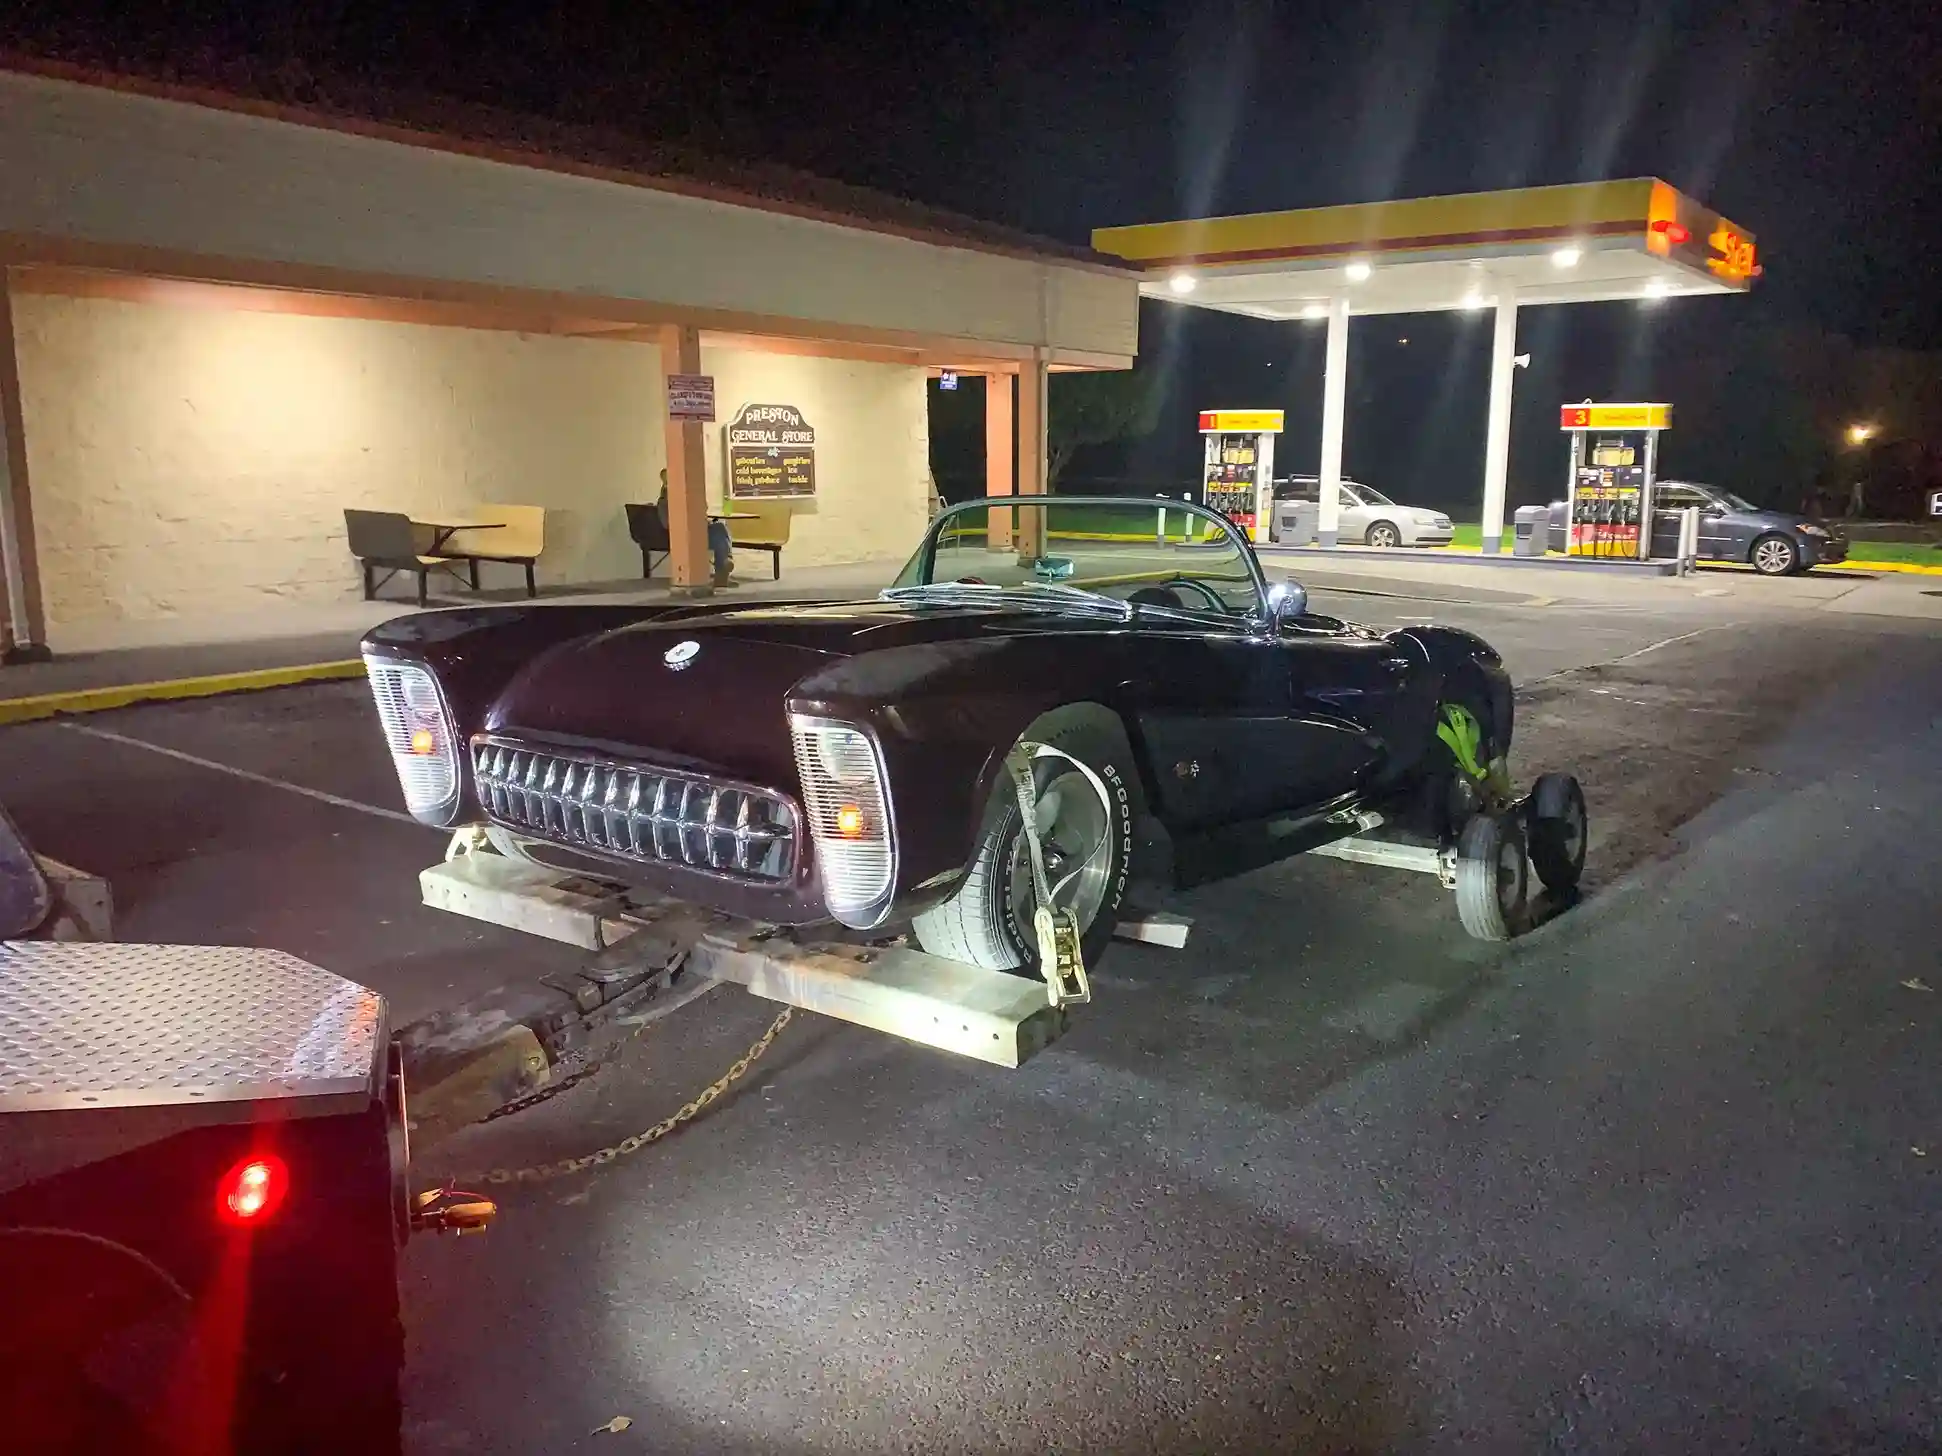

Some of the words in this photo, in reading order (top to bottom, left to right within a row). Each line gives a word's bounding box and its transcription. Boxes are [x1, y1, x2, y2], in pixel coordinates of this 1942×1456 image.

[745, 407, 799, 426] PRESTON
[1574, 410, 1586, 425] 3
[731, 430, 778, 444] GENERAL
[781, 430, 813, 444] STORE
